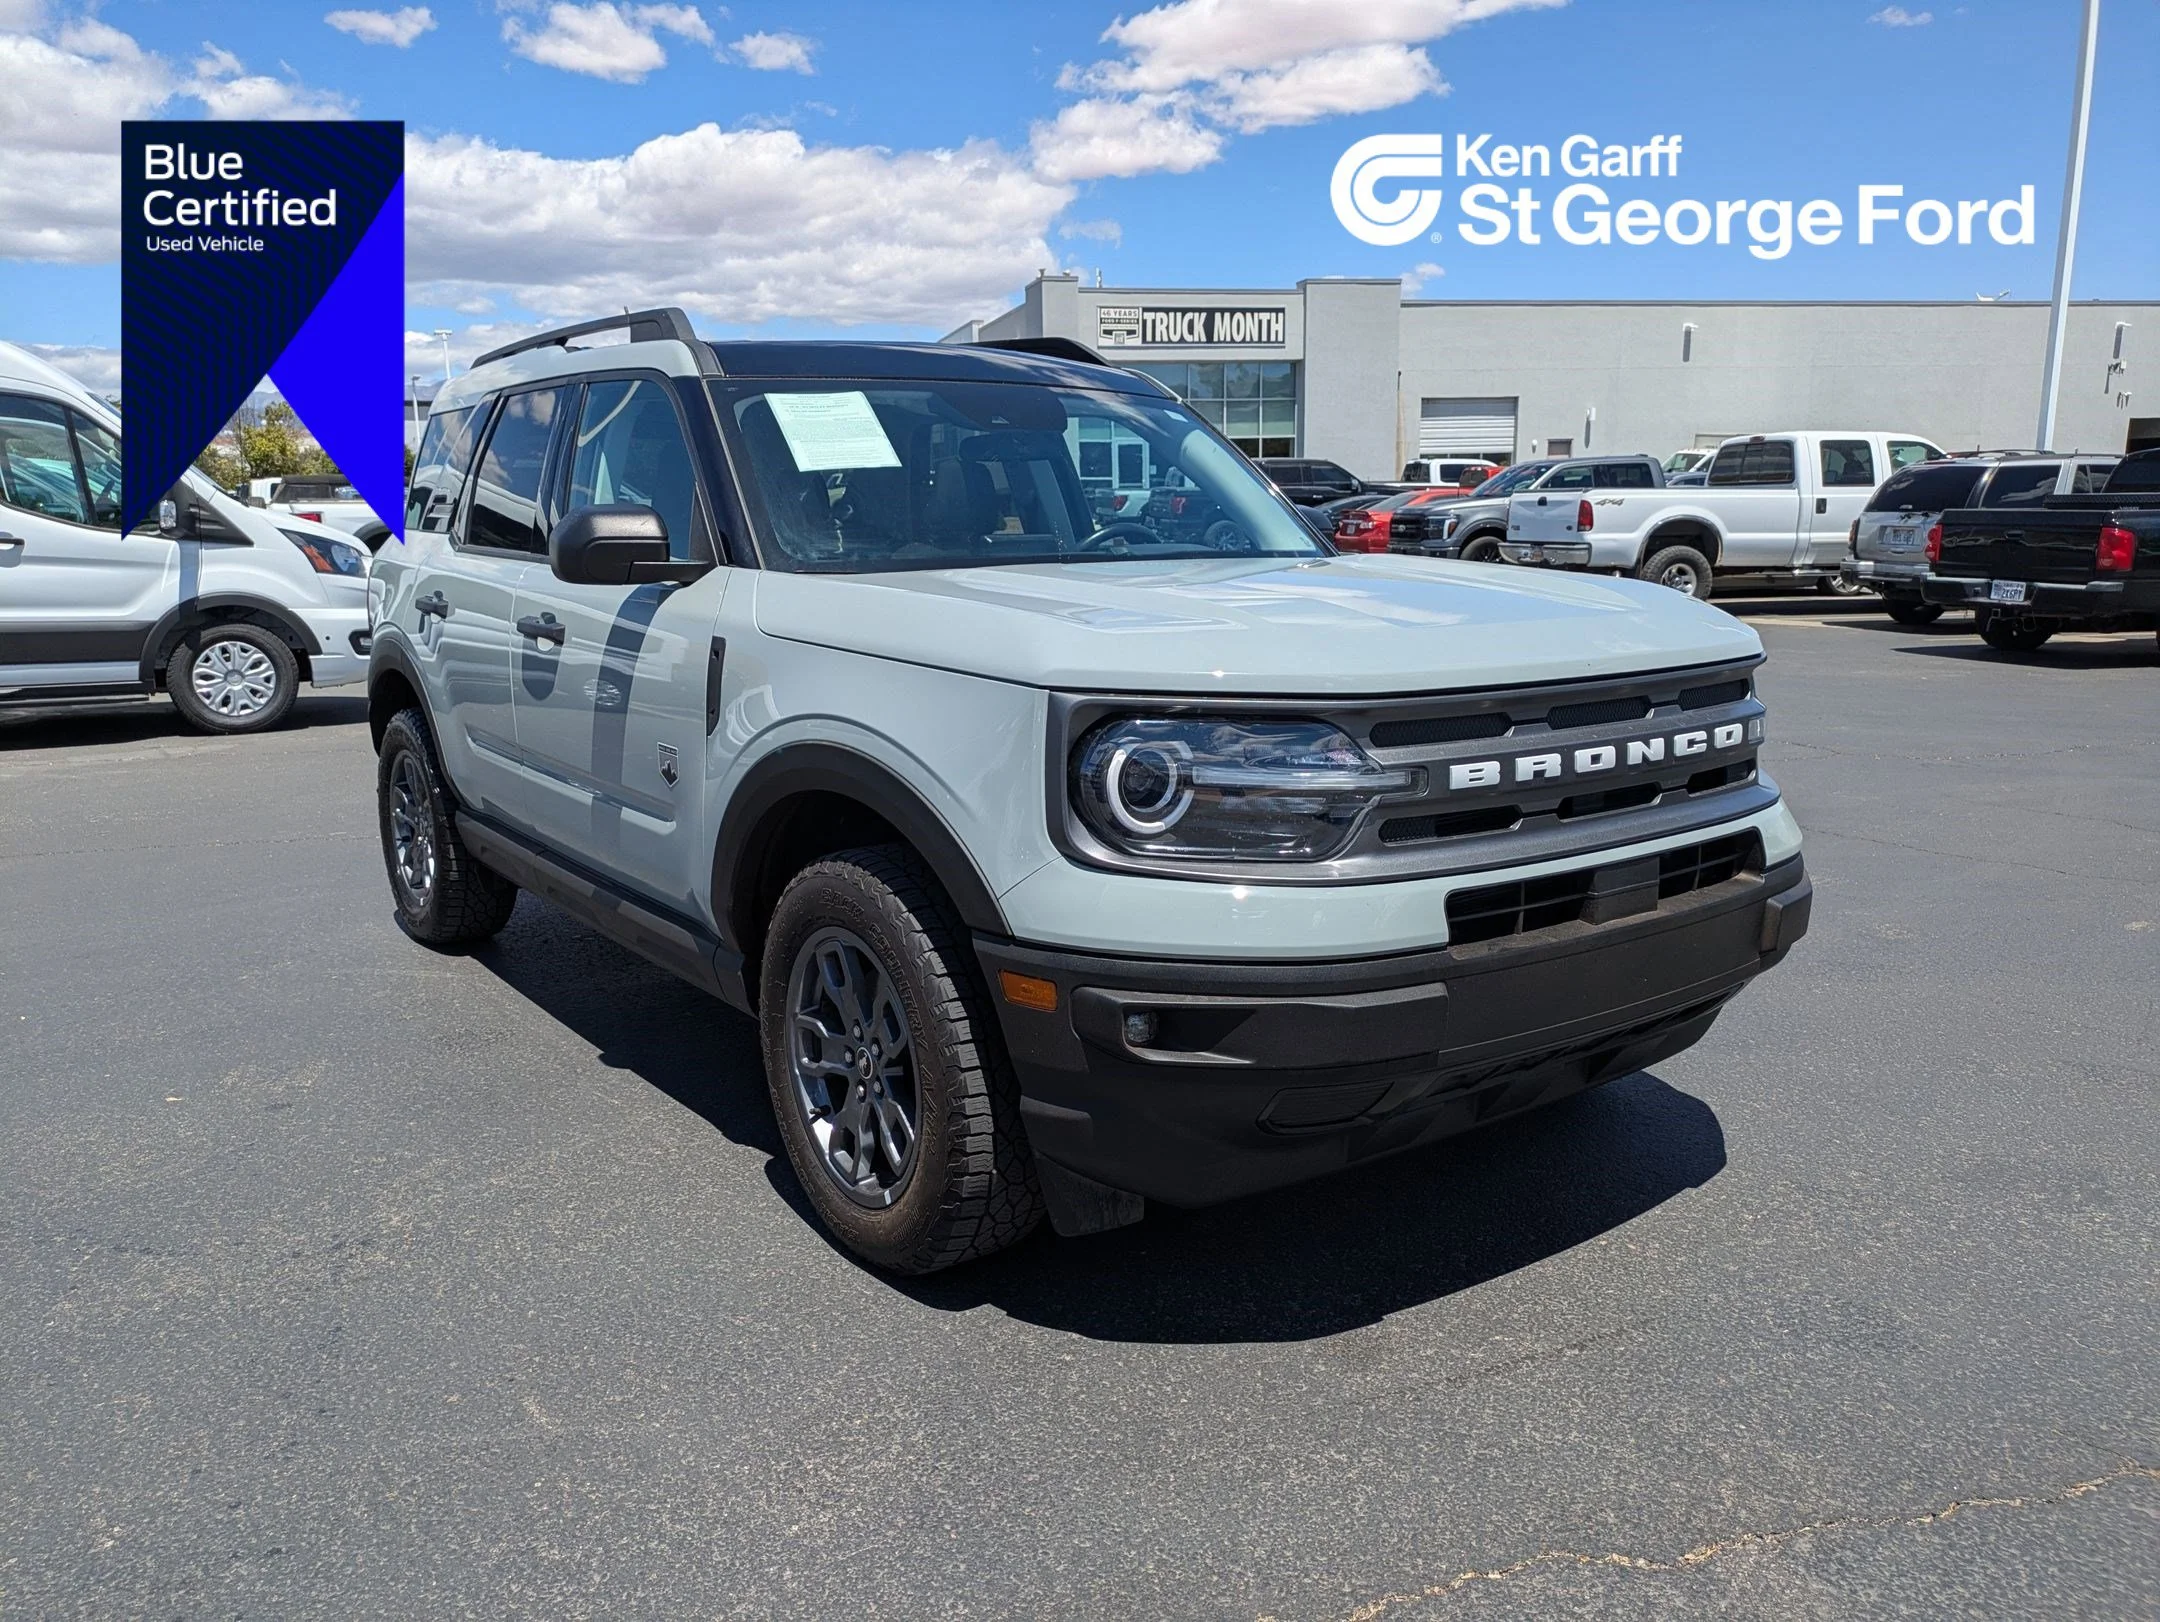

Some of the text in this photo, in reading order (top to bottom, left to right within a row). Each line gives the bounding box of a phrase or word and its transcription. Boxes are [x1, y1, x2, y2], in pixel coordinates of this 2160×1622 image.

[1143, 311, 1284, 342] TRUCK MONTH
[1448, 722, 1744, 790] BRONCO
